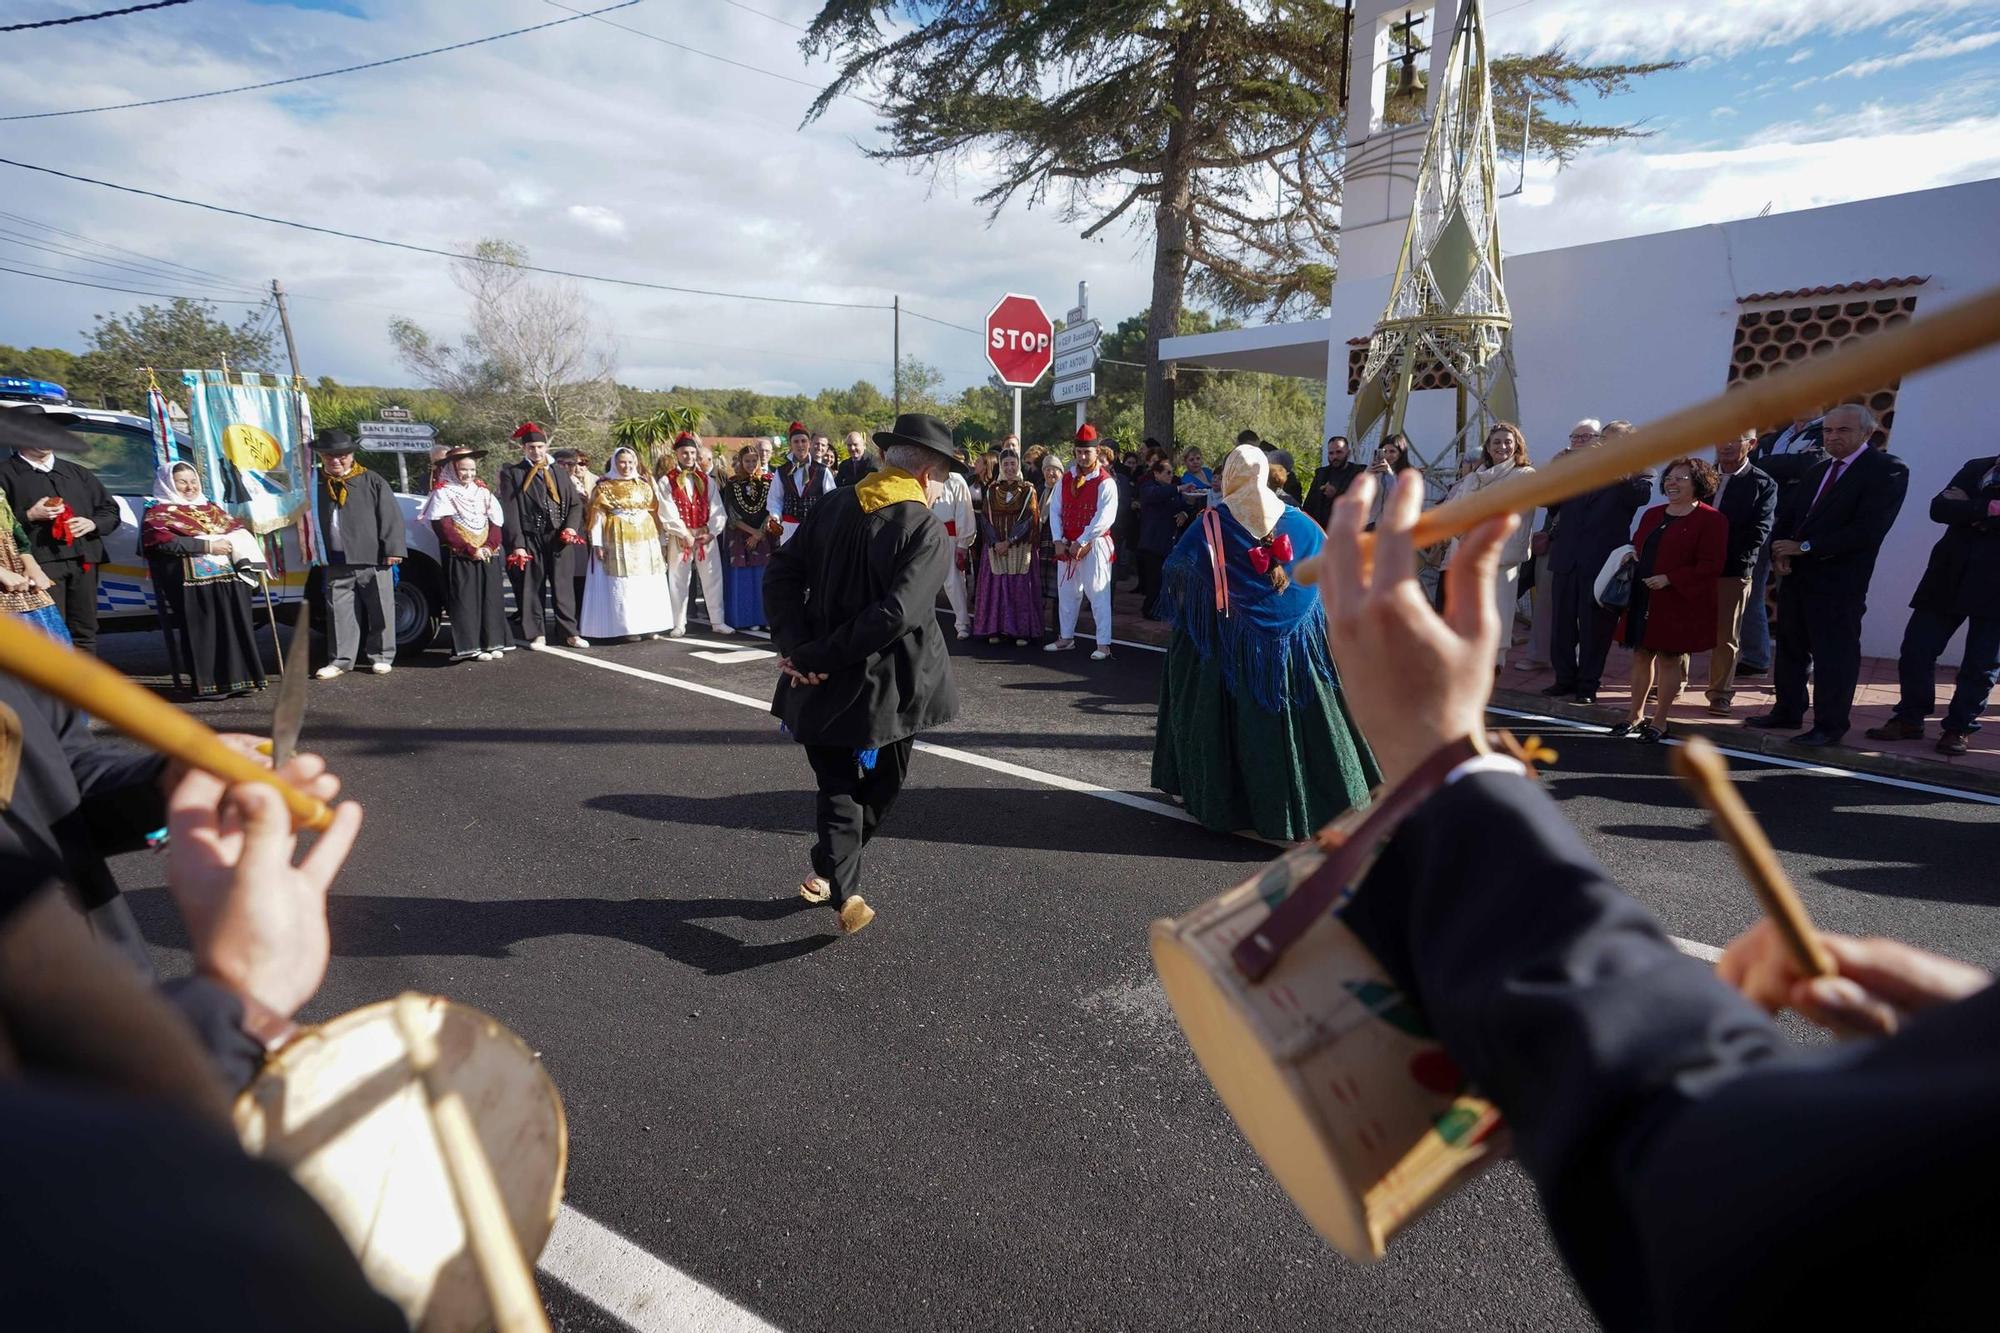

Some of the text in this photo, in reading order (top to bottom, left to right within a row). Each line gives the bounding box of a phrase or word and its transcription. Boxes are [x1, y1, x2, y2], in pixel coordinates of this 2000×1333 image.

[991, 327, 1049, 353] STOP
[1056, 354, 1088, 372] SANT ANTONI
[1062, 380, 1090, 396] SANT RAFEL
